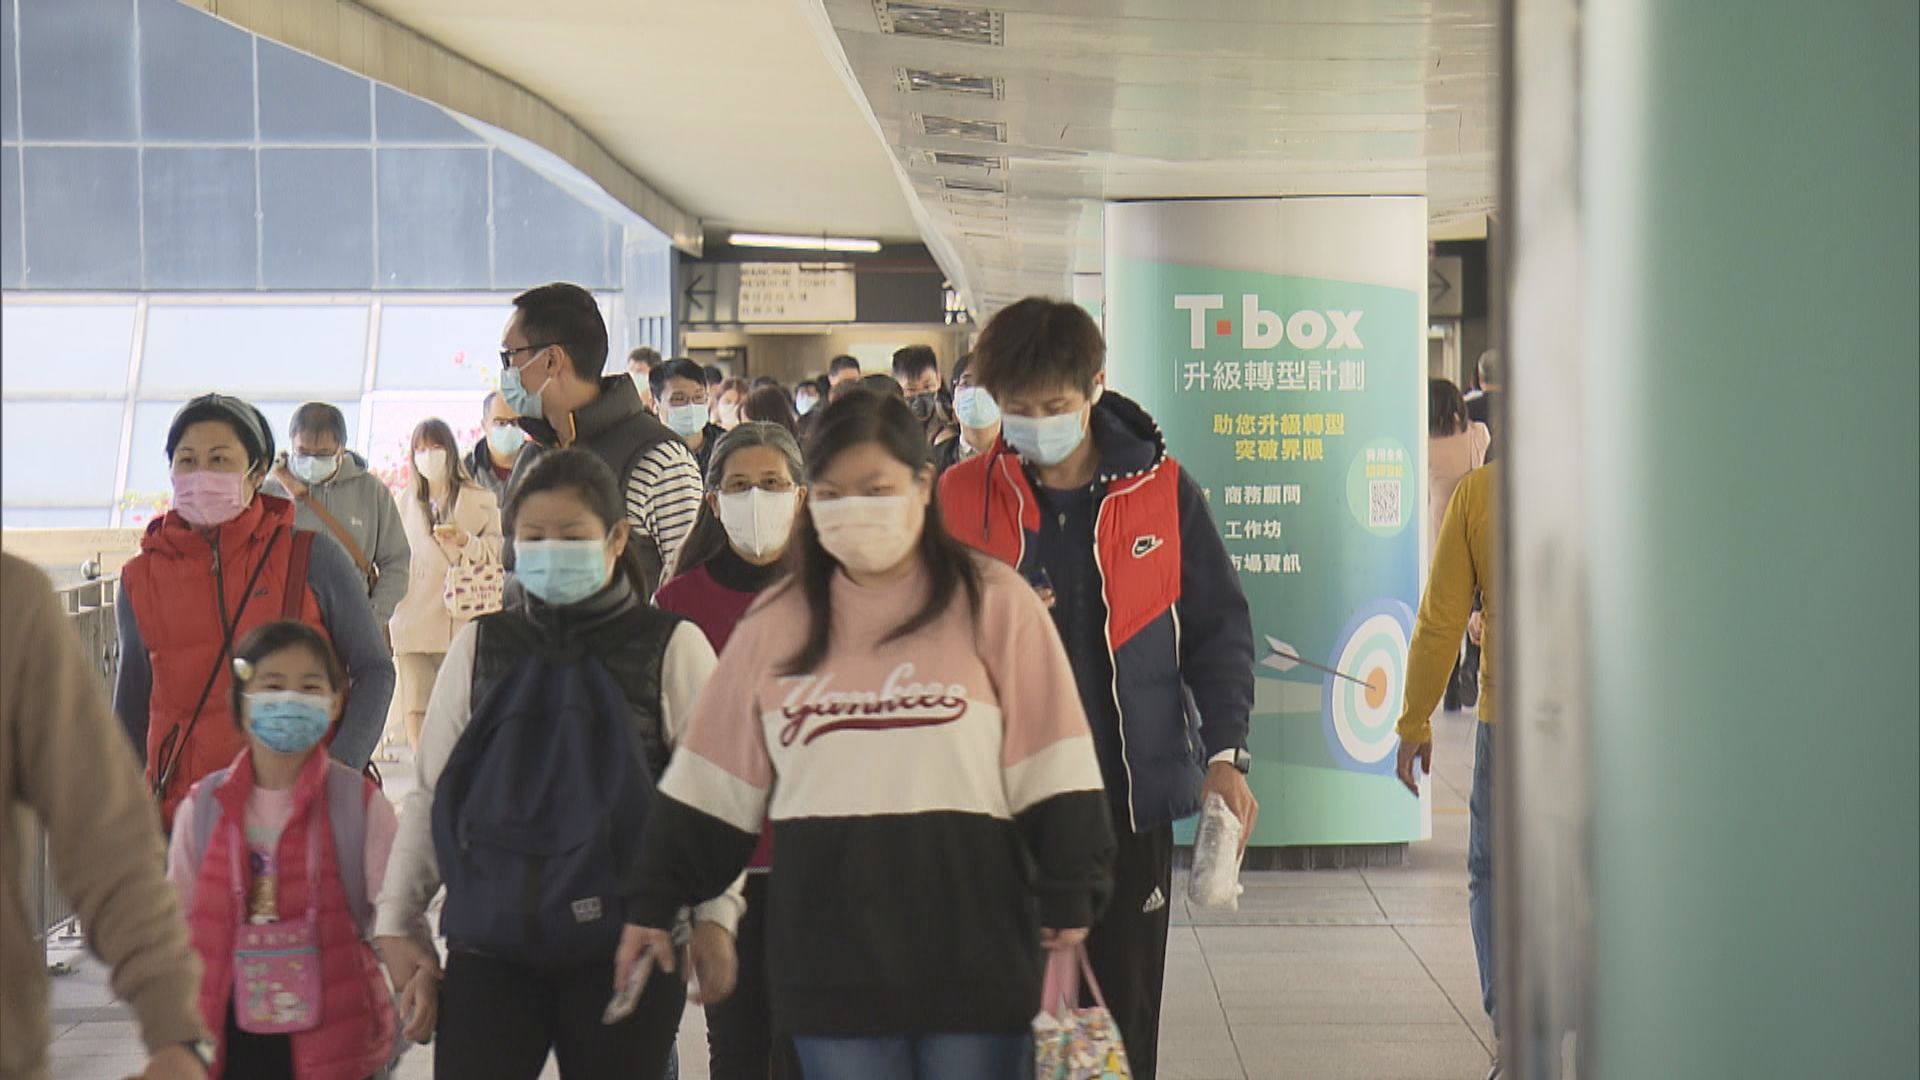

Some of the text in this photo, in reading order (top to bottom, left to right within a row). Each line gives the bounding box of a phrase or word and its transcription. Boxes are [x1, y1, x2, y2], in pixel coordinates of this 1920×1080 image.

[1183, 360, 1365, 392] 升級轉型計劃
[1213, 413, 1344, 435] 助您升級轉型
[1235, 438, 1323, 461] 突破界限
[1224, 484, 1301, 505] 商務顧問
[1224, 519, 1281, 539] 工作坊
[778, 662, 968, 747] Yankees
